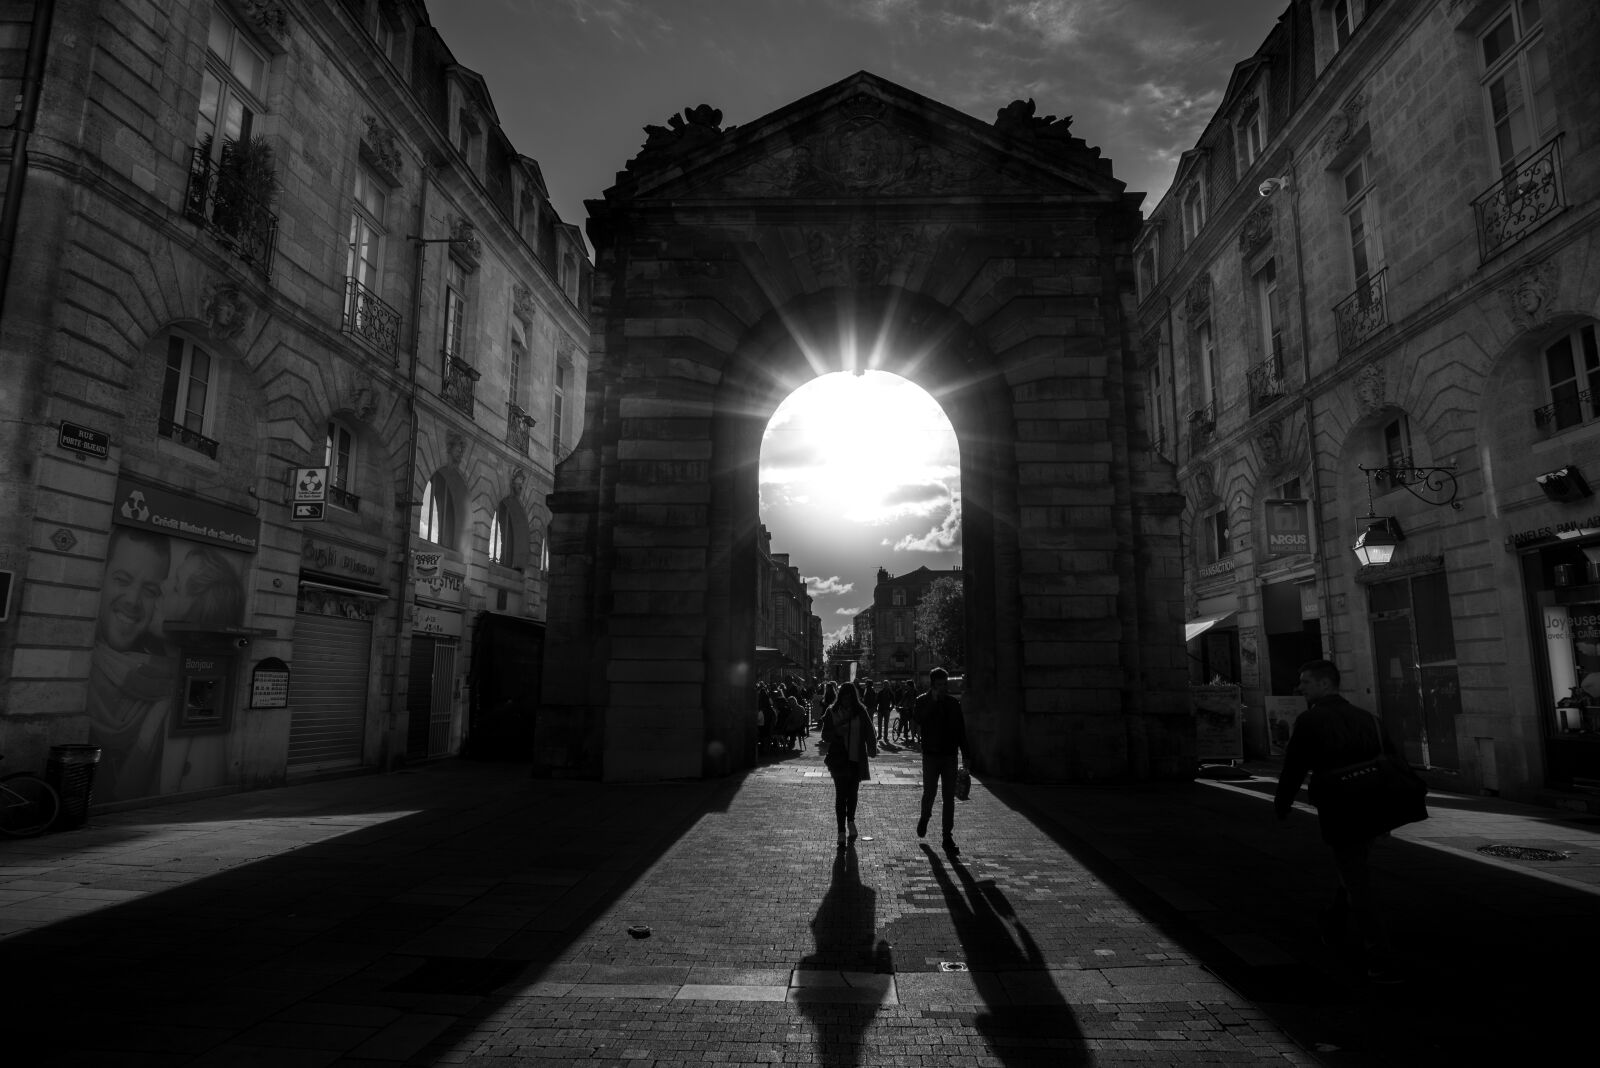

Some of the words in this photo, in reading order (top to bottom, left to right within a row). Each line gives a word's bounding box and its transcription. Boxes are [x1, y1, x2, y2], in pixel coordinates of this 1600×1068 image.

[79, 430, 94, 441] RUE
[1270, 534, 1306, 545] ARGUS
[415, 554, 441, 562] DOGGY
[185, 658, 215, 672] Bonjour
